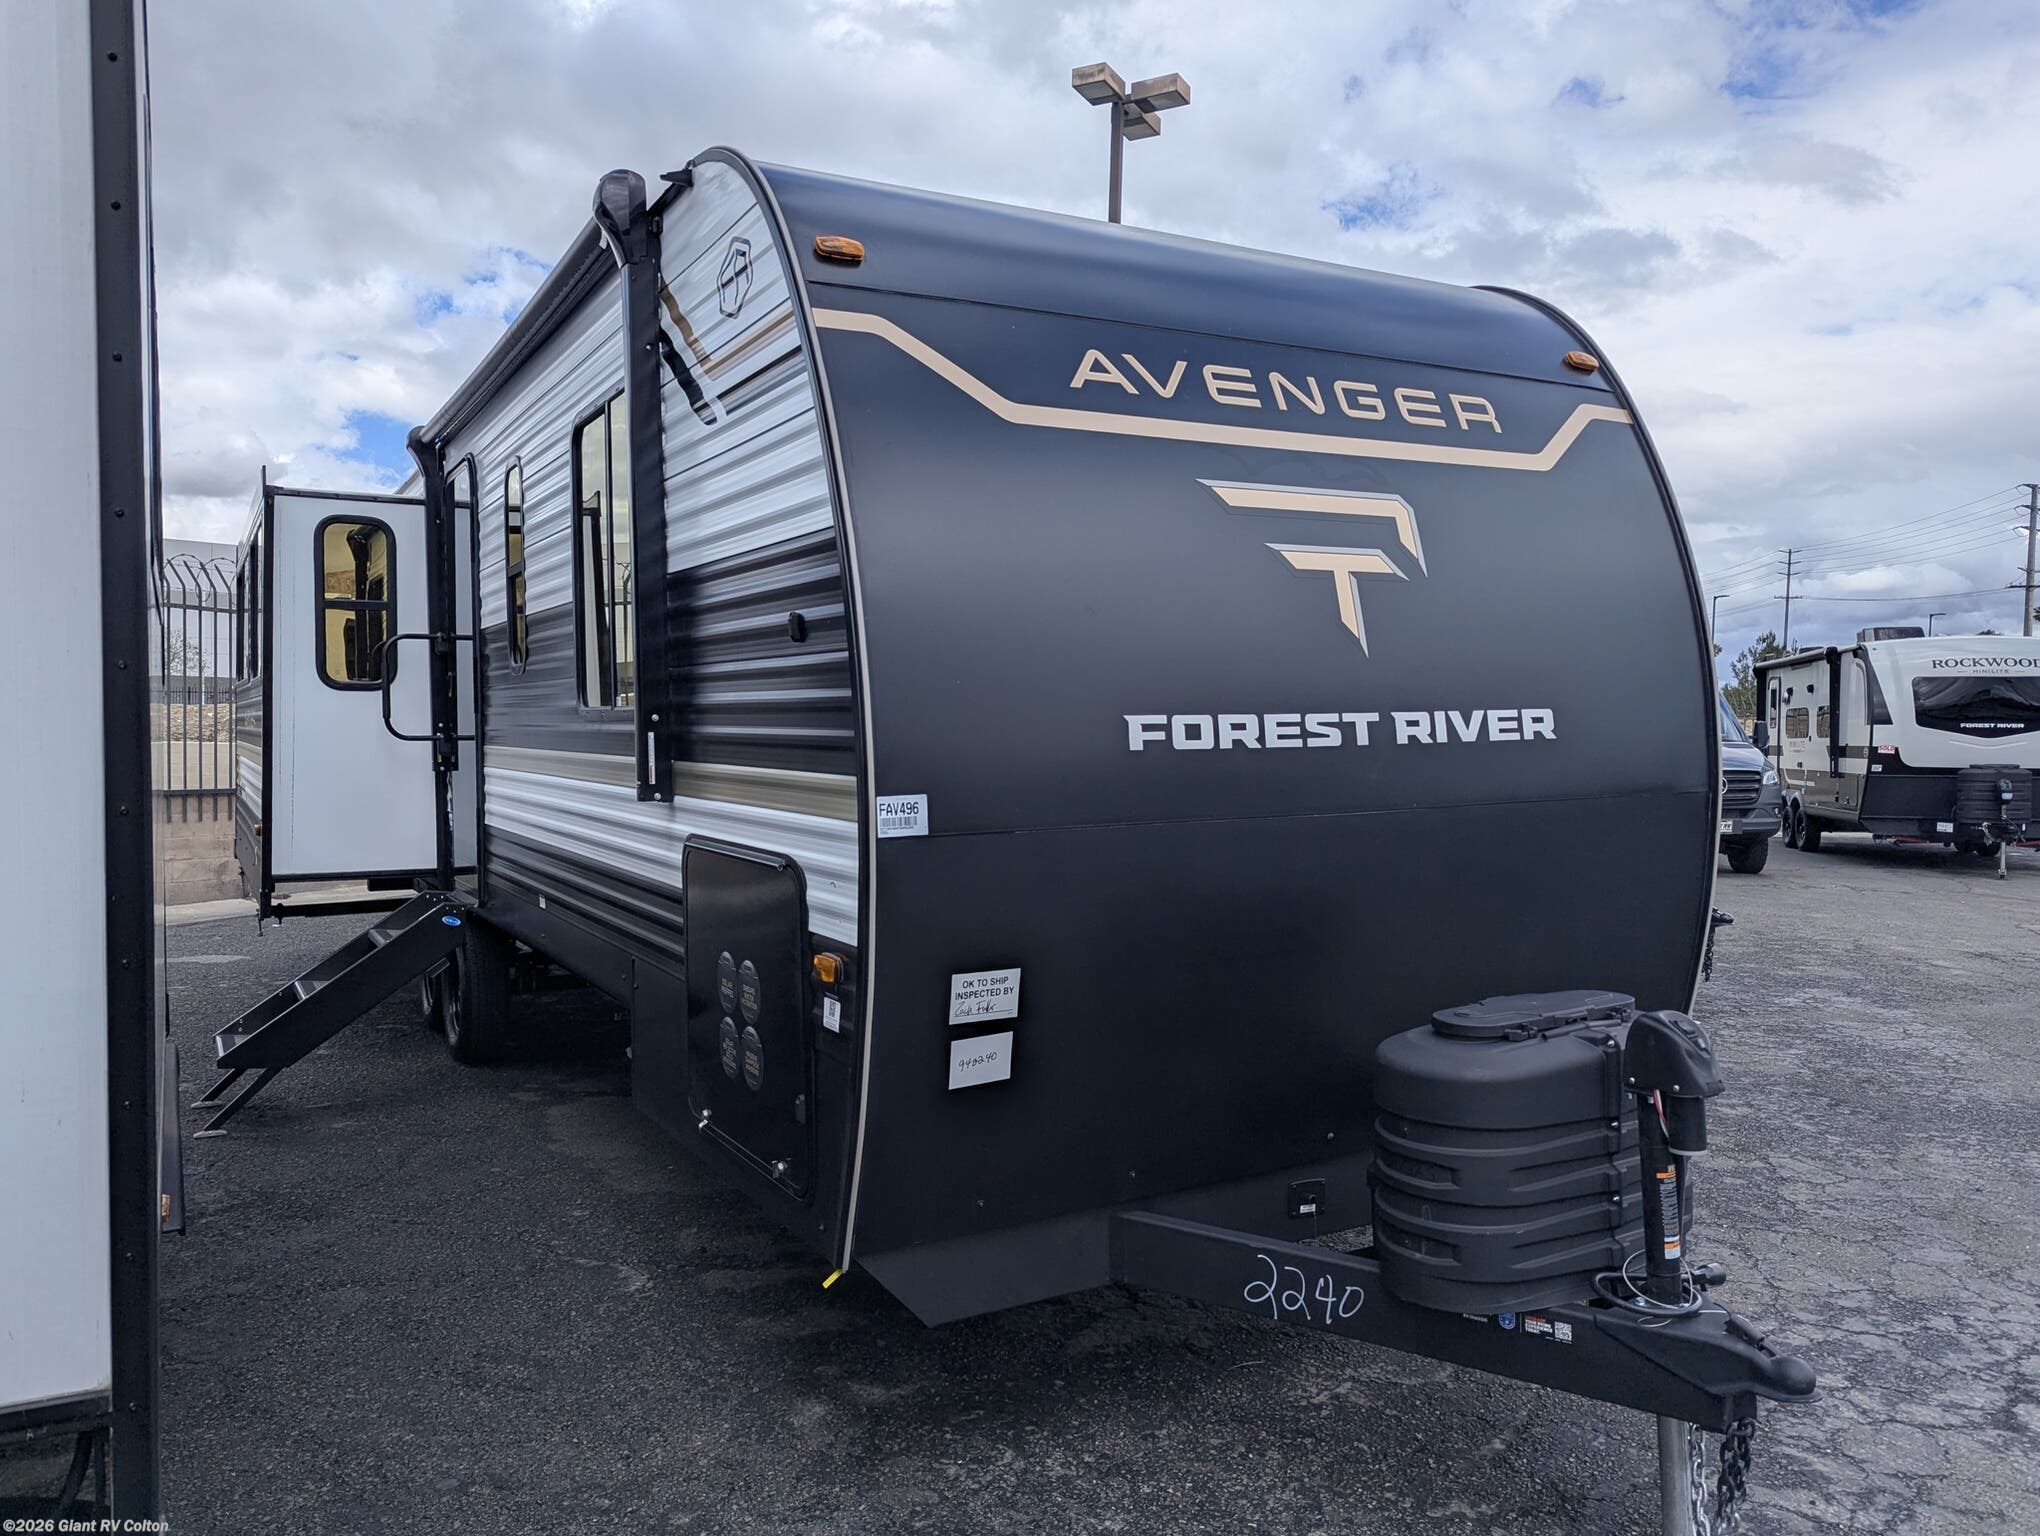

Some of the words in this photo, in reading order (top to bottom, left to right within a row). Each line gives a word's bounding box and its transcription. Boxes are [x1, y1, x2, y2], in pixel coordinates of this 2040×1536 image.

[1070, 349, 1502, 433] AVENGER
[1123, 712, 1379, 751] FOREST
[1390, 708, 1556, 744] RIVER
[879, 801, 919, 817] FAV496
[955, 988, 1001, 1000] INSPECTED
[1003, 986, 1015, 995] BY
[962, 980, 975, 989] OK
[977, 979, 988, 988] TO
[990, 976, 1009, 986] SHIP
[1244, 1254, 1364, 1325] 2240
